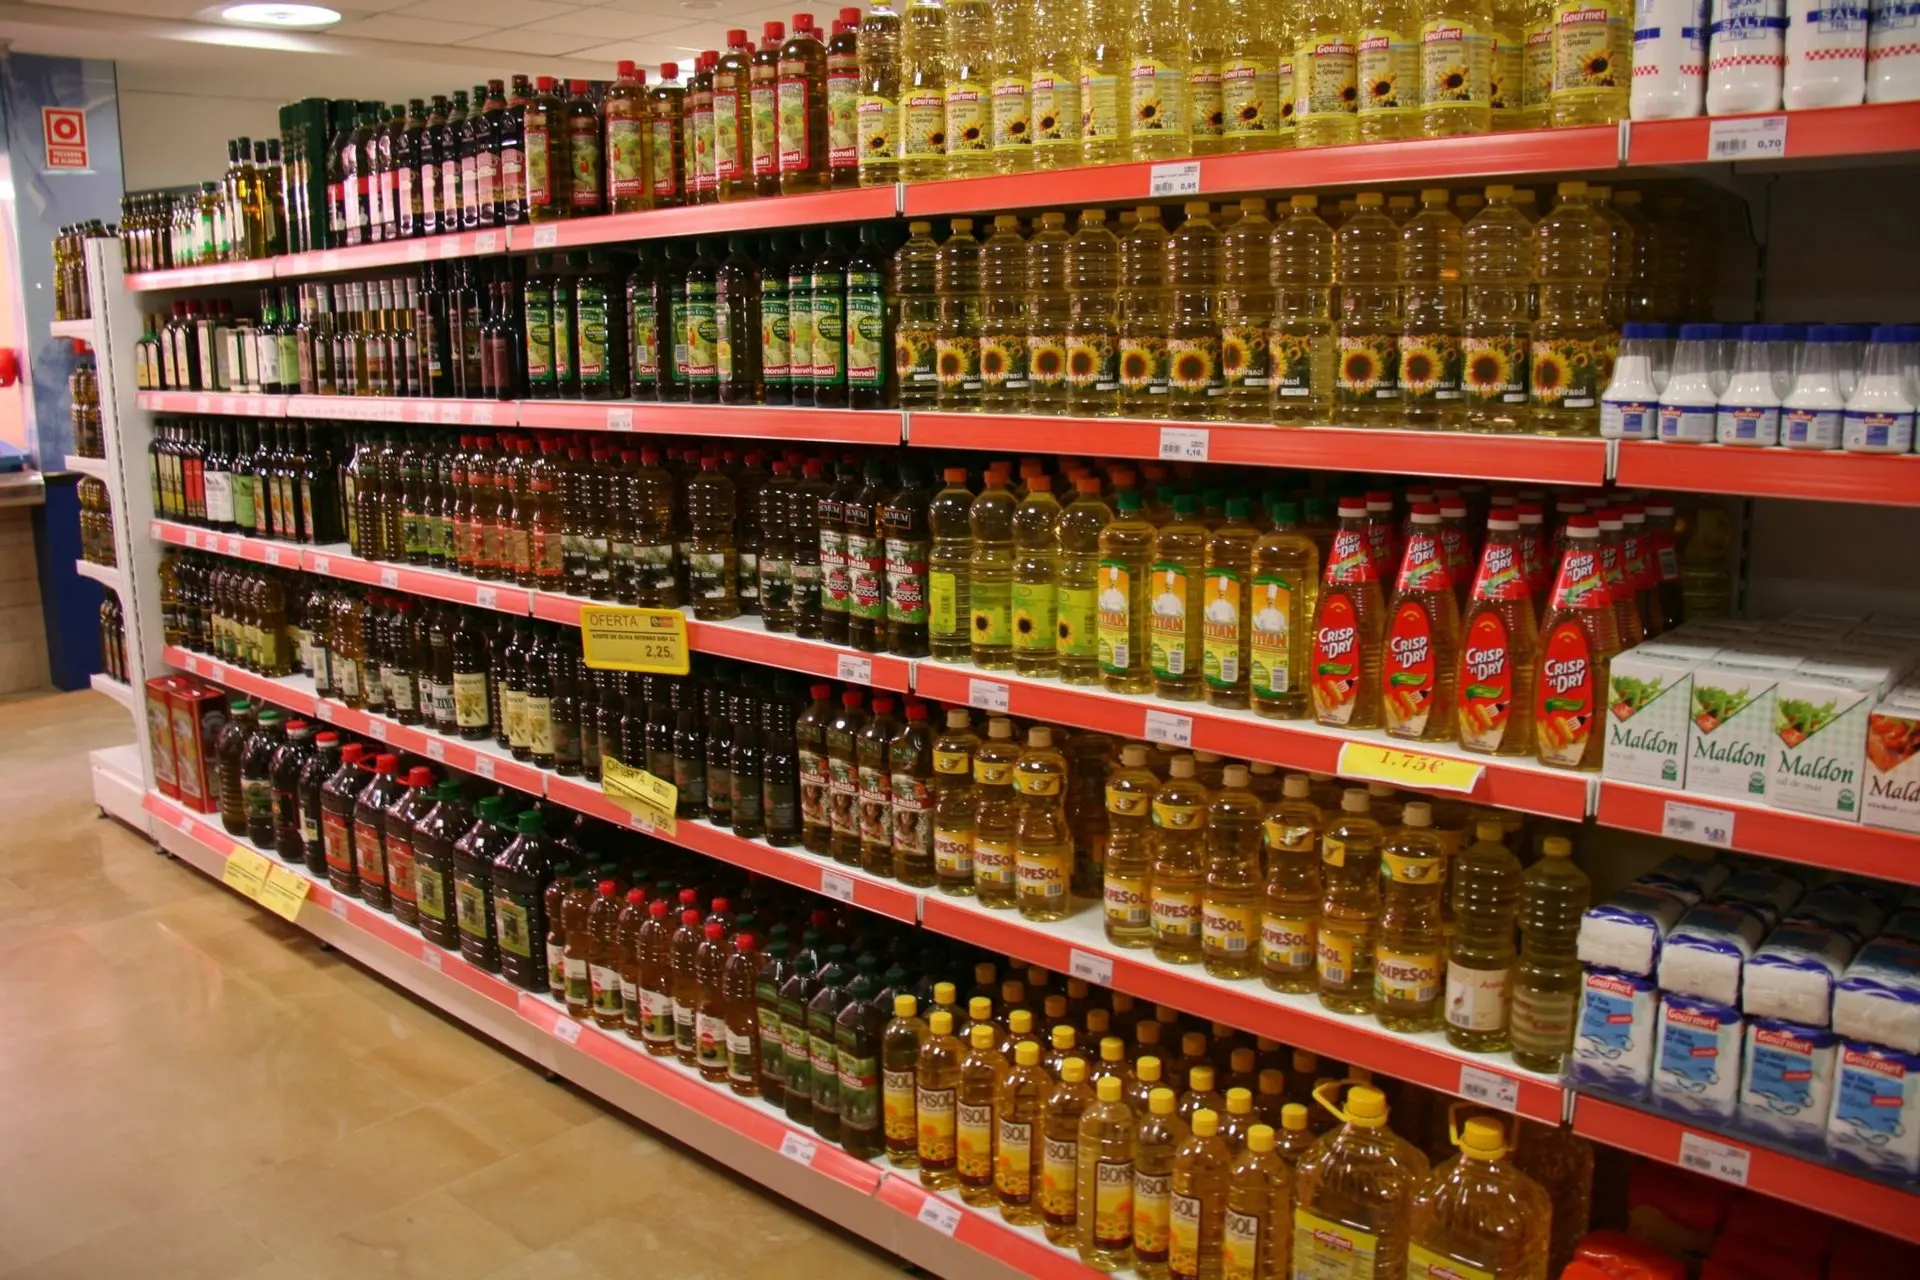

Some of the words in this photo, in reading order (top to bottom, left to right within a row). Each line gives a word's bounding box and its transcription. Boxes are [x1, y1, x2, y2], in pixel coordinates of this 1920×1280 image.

[1563, 11, 1605, 23] Gourmet
[1721, 18, 1763, 30] SALT
[1425, 29, 1461, 41] Gourmet
[911, 98, 943, 107] Gourmet
[1757, 138, 1782, 149] 0,70
[1000, 371, 1023, 380] Girasol
[1088, 373, 1113, 382] Girasol
[1141, 375, 1167, 384] Girasol
[1236, 367, 1264, 377] Girasol
[1275, 377, 1300, 386] Girasol
[1368, 378, 1394, 389] Girasol
[1427, 378, 1456, 389] Girasol
[1492, 380, 1523, 392] Girasol
[1554, 385, 1586, 397] Girasol
[1335, 533, 1361, 547] CRISP
[1409, 539, 1435, 554] CRISP
[1341, 542, 1361, 558] DRY
[1415, 548, 1435, 565] DRY
[1484, 547, 1513, 562] CRISP
[1491, 556, 1513, 573] DRY
[1564, 554, 1594, 570] CRISP
[1572, 563, 1594, 582] DRY
[589, 614, 638, 628] OFERTA
[1318, 627, 1354, 644] CRISP
[1328, 637, 1354, 659] DRY
[1391, 636, 1428, 653] CRISP
[1402, 646, 1428, 669] DRY
[1465, 647, 1504, 665] CRISP
[1477, 658, 1504, 681] DRY
[1544, 659, 1585, 677] CRISP
[1556, 670, 1586, 694] DRY
[1610, 724, 1679, 756] Maldon
[1693, 735, 1766, 768] Maldon
[1379, 750, 1444, 776] 1.75€
[1777, 750, 1854, 784] Maldon
[1868, 774, 1920, 803] Mald
[1588, 975, 1632, 997] Gourmet
[1668, 1008, 1717, 1031] Gourmet
[1757, 1030, 1810, 1054] Gourmet
[1845, 1051, 1902, 1077] Gourmet
